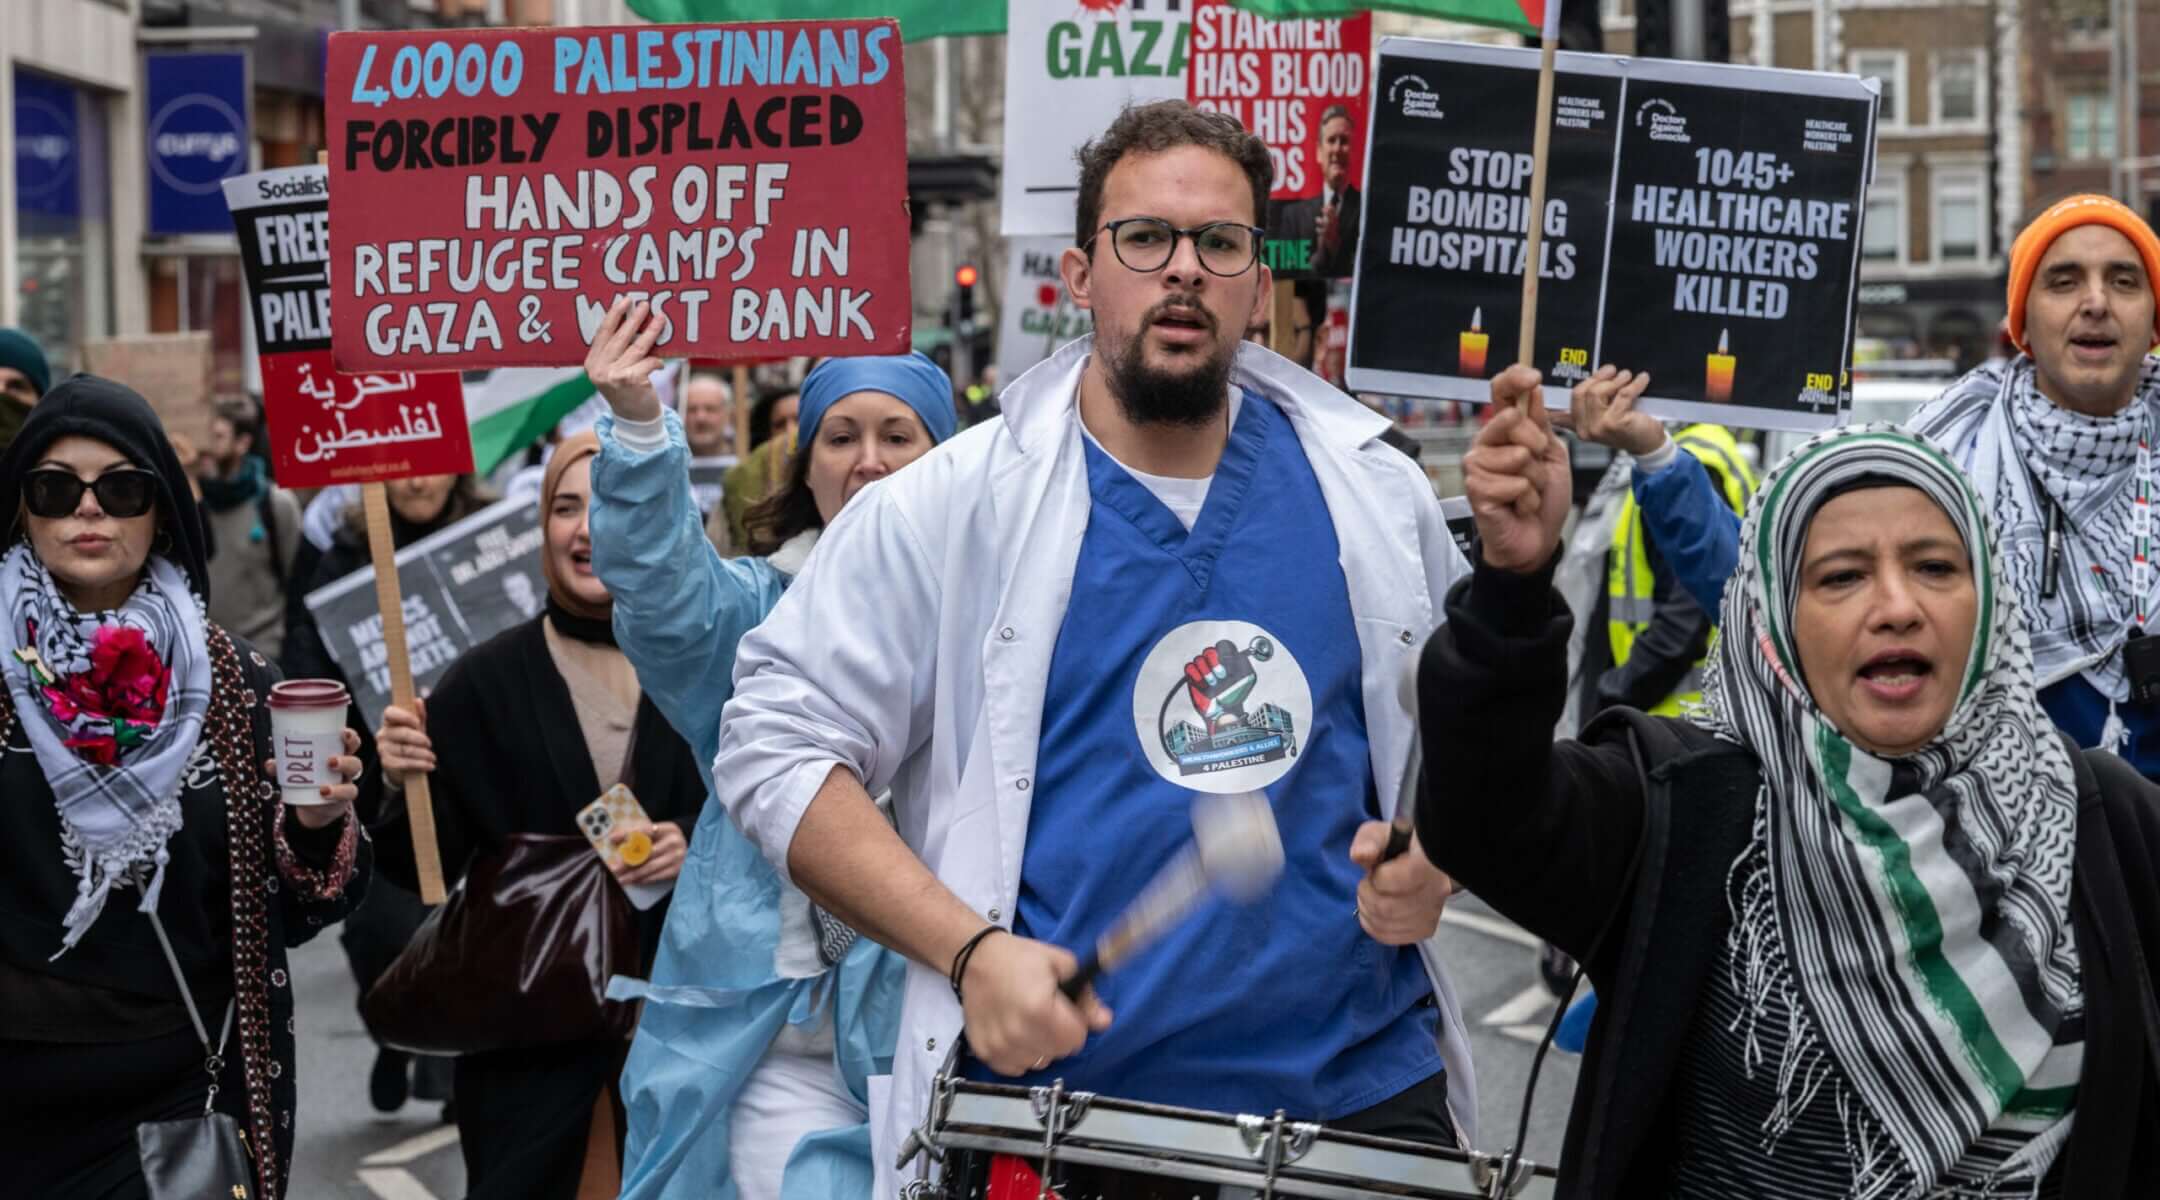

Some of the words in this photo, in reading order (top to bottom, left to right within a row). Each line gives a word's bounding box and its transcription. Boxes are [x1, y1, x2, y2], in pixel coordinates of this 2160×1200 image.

[352, 41, 523, 108] 40000
[554, 27, 892, 96] PALESTINIANS
[1046, 20, 1192, 80] GAZA
[1194, 51, 1262, 98] HAS
[1270, 51, 1365, 98] BLOOD
[156, 132, 240, 162] currys
[345, 113, 560, 172] FORCIBLY
[586, 95, 864, 158] DISPLACED
[1252, 100, 1307, 145] HIS
[1447, 147, 1534, 190] STOP
[1695, 146, 1795, 191] 1045+
[465, 166, 656, 231] HANDS
[671, 162, 790, 226] OFF
[1631, 184, 1851, 240] HEALTHCARE
[354, 234, 583, 298] REFUGEE
[603, 226, 764, 285] CAMPS
[791, 227, 850, 278] IN
[1654, 228, 1819, 280] WORKERS
[1673, 272, 1789, 320] KILLED
[364, 298, 503, 356] GAZA
[517, 295, 553, 345] &
[729, 287, 875, 342] BANK
[1560, 347, 1588, 366] END
[1806, 372, 1833, 391] END
[294, 400, 443, 463] لفلسطين
[284, 736, 315, 785] PRET
[1202, 761, 1210, 772] 4
[1211, 754, 1266, 771] PALESTINE
